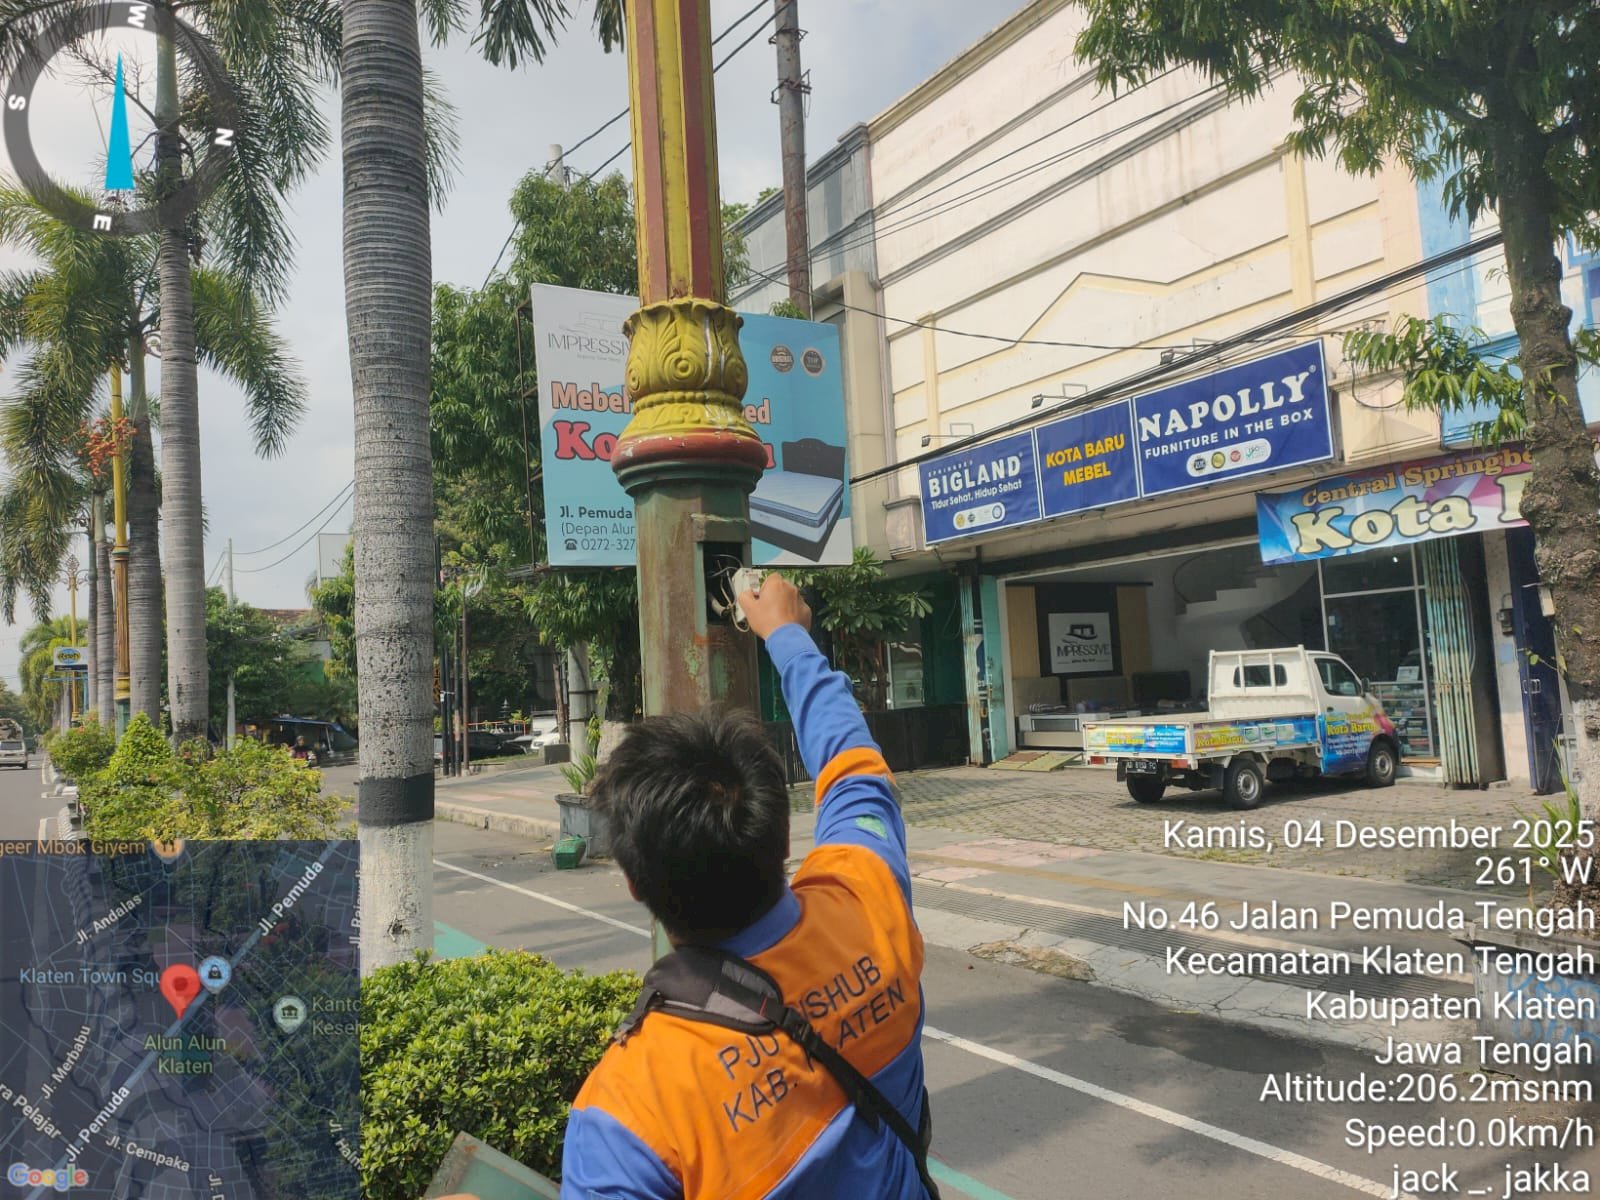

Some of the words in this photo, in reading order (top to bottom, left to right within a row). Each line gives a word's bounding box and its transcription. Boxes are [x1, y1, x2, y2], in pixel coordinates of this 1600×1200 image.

[551, 381, 631, 415] Mebel
[1138, 371, 1310, 442] NAPOLLY
[1046, 446, 1083, 468] KOTA
[1084, 433, 1125, 458] BARU
[1145, 432, 1219, 460] FURNITURE
[1224, 426, 1239, 440] IN
[1244, 418, 1274, 435] THE
[1280, 408, 1314, 427] BOX
[928, 456, 1021, 498] BIGLAND
[974, 486, 998, 499] Hidup
[998, 479, 1023, 493] Sehat
[1063, 461, 1112, 486] MEBEL
[1302, 472, 1398, 507] Central
[560, 505, 574, 518] Jl.
[578, 505, 633, 519] Pemuda
[561, 521, 608, 537] (Depan
[1291, 495, 1478, 554] Kota
[722, 1068, 798, 1133] KAB.
